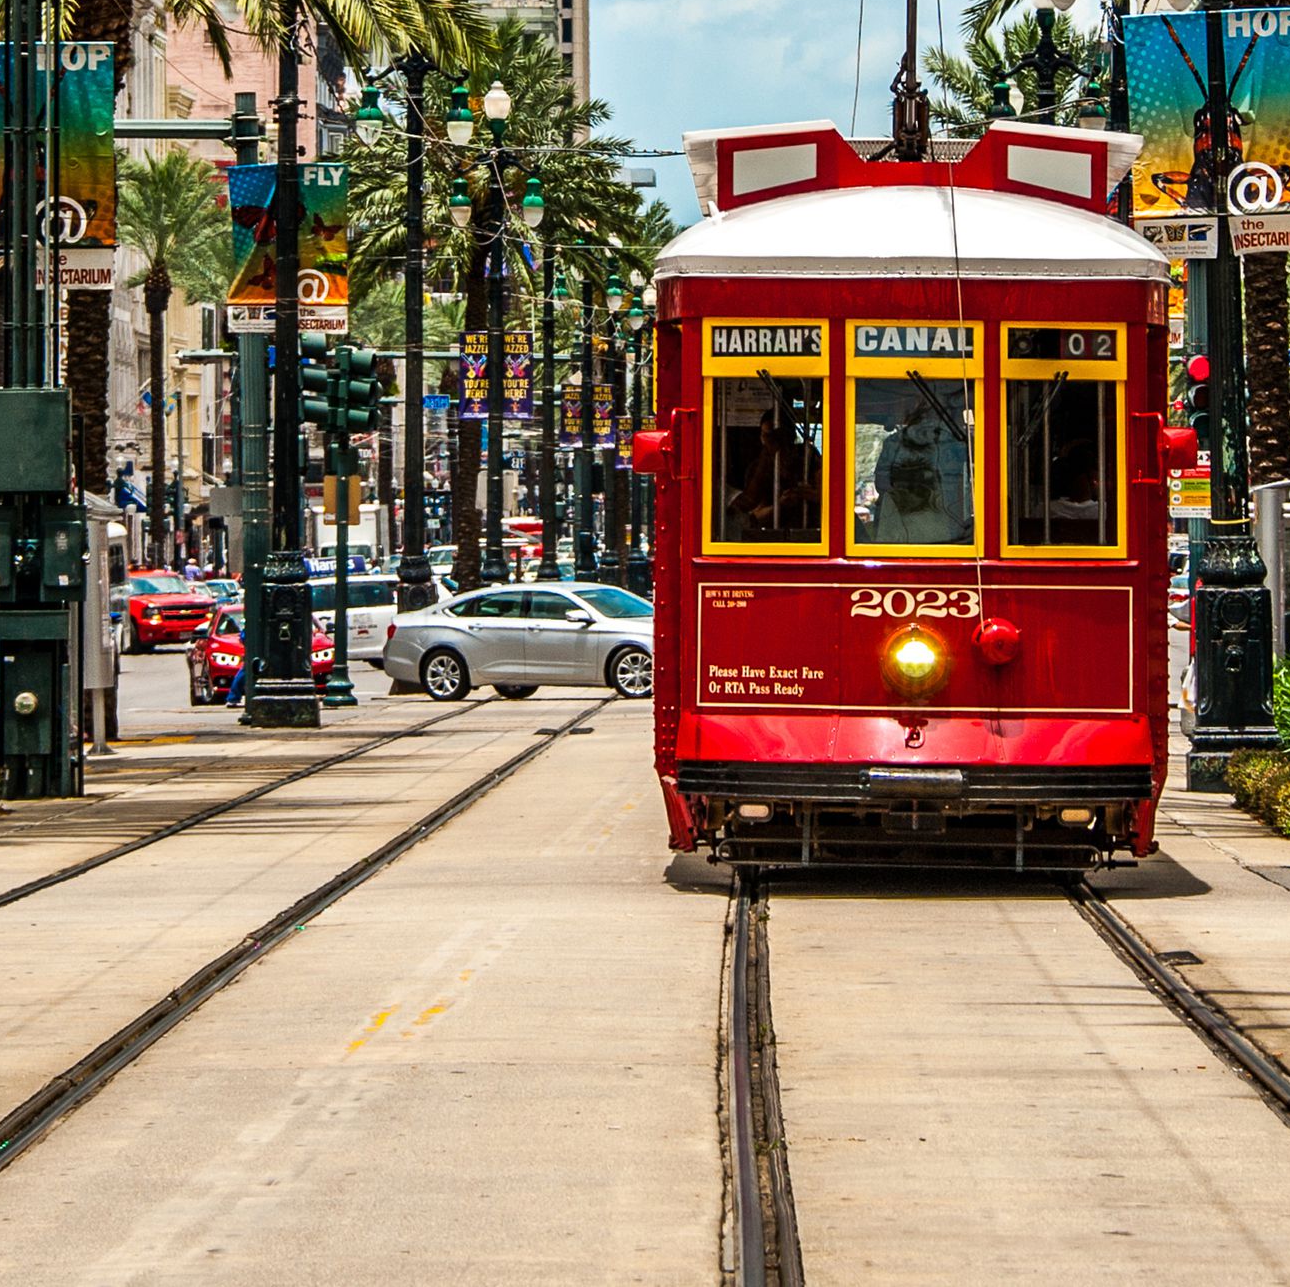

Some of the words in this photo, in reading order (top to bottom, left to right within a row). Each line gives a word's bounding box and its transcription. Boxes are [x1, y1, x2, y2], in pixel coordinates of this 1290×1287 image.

[303, 167, 344, 186] FLY
[1241, 219, 1264, 230] the
[300, 307, 316, 317] the
[713, 327, 822, 354] HARRAH'S
[856, 326, 974, 353] CANAL
[850, 588, 980, 618] 2023
[709, 664, 738, 677] Please
[741, 665, 766, 678] Have
[769, 666, 798, 679] Exact
[802, 667, 824, 679] Fare
[708, 682, 721, 693] Or
[725, 682, 745, 694] RTA
[749, 682, 770, 694] Pass
[774, 683, 804, 698] Ready
